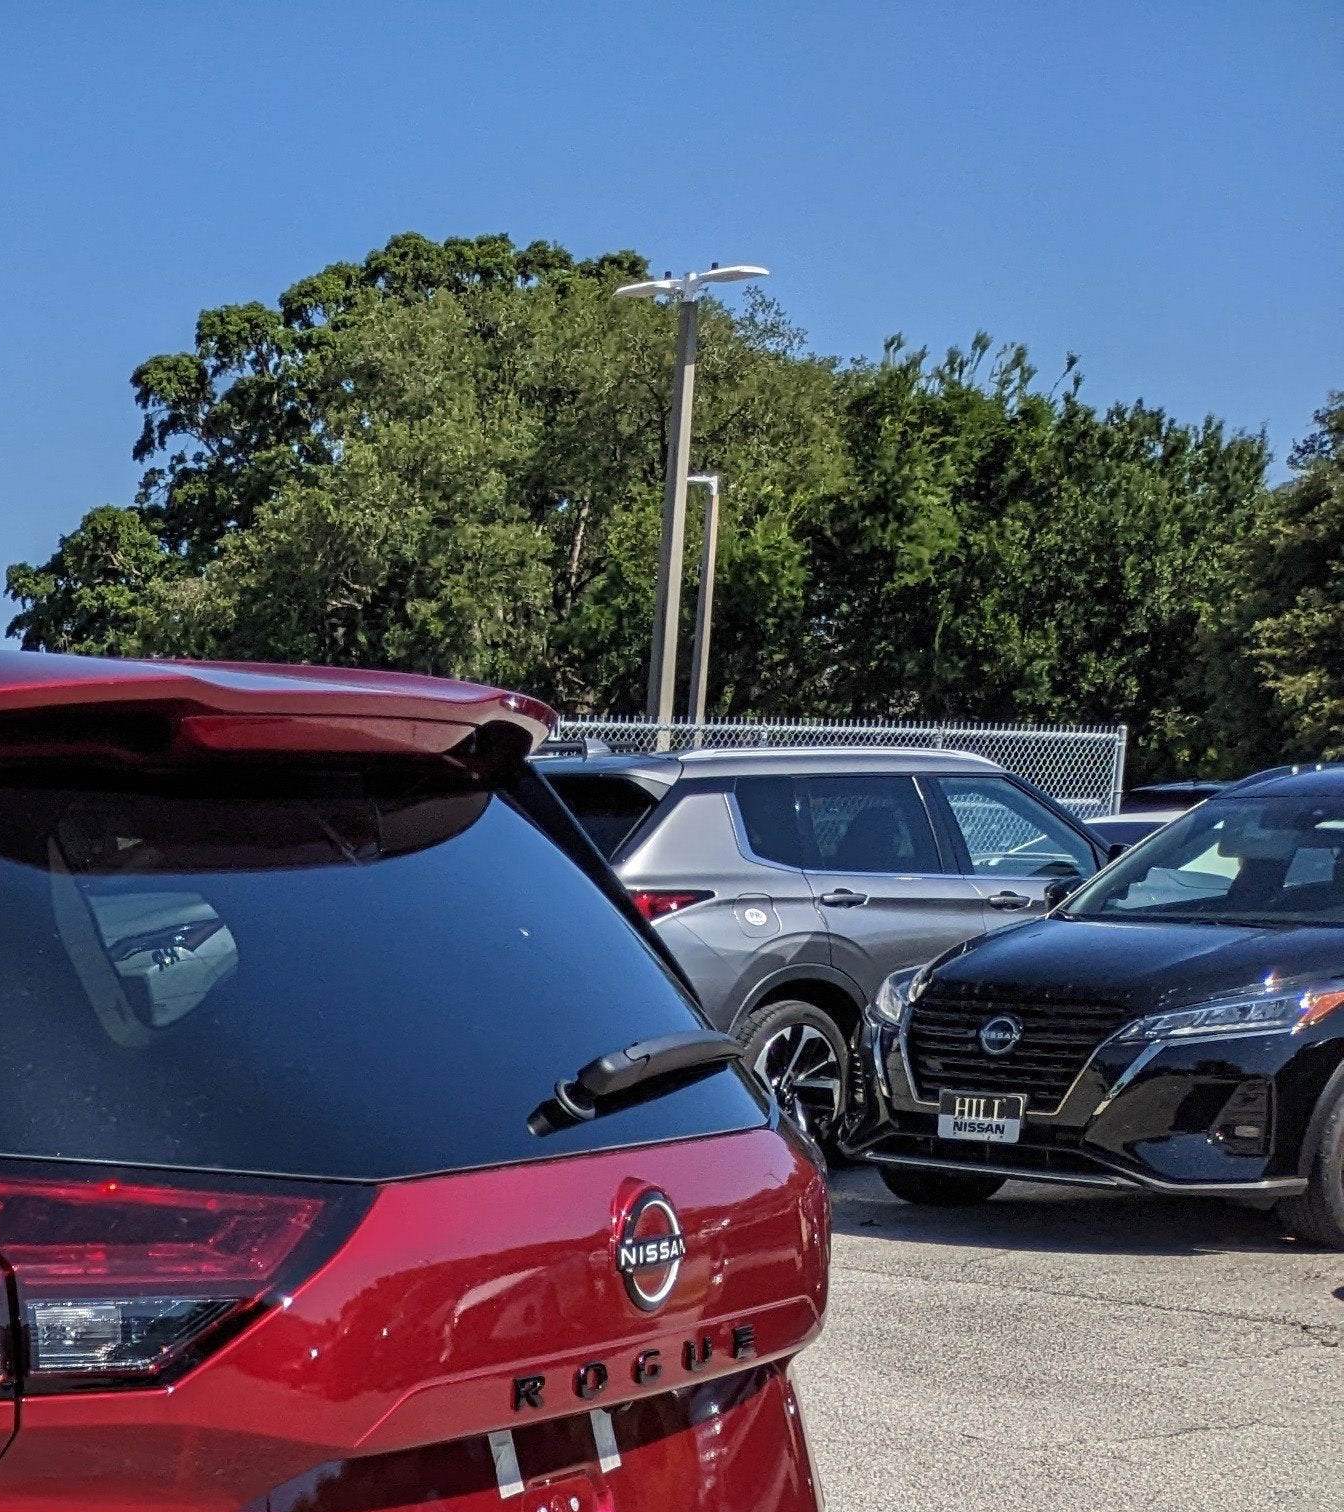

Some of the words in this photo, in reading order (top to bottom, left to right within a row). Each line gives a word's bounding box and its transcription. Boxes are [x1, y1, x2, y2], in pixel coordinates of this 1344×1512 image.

[980, 1030, 1020, 1041] NISSAN
[953, 1096, 1007, 1121] HILL
[953, 1121, 1006, 1135] NISSAN
[620, 1238, 686, 1266] NISSAN
[511, 1324, 754, 1412] ROGUE
